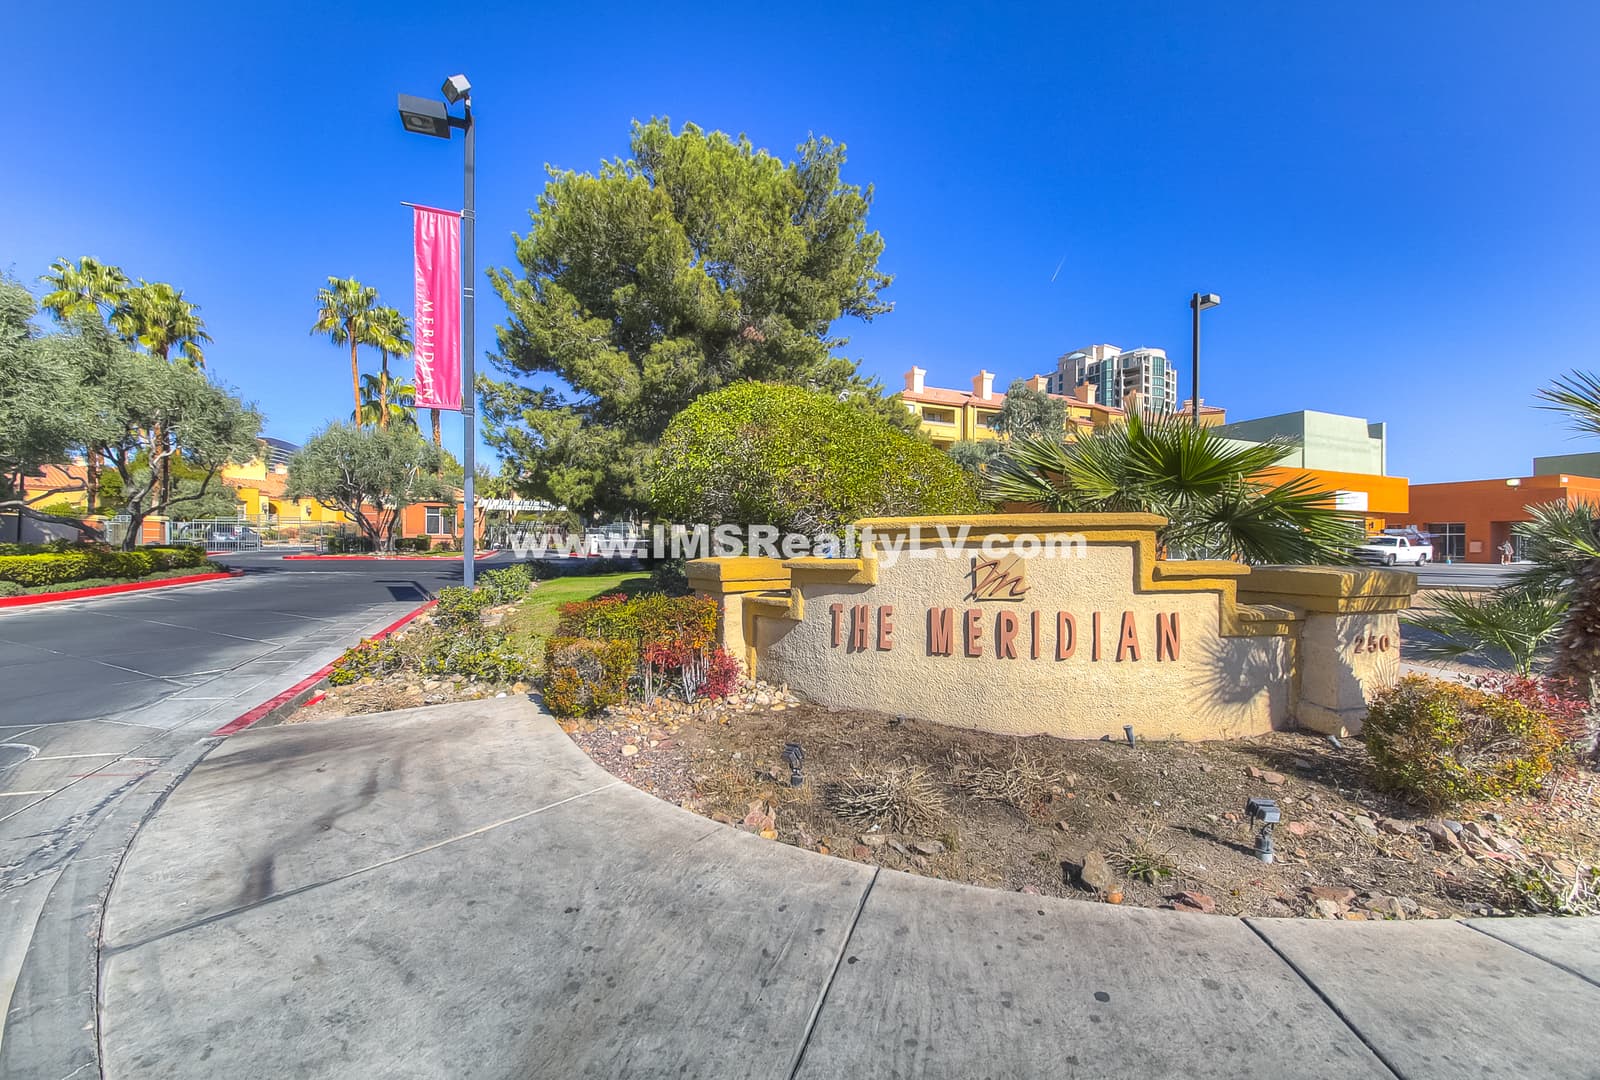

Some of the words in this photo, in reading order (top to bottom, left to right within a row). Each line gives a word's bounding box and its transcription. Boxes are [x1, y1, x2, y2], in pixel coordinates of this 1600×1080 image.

[422, 299, 435, 400] MERIDIAN
[829, 602, 894, 652] THE
[927, 607, 1181, 662] MERIDIAN
[1353, 634, 1390, 654] 250
